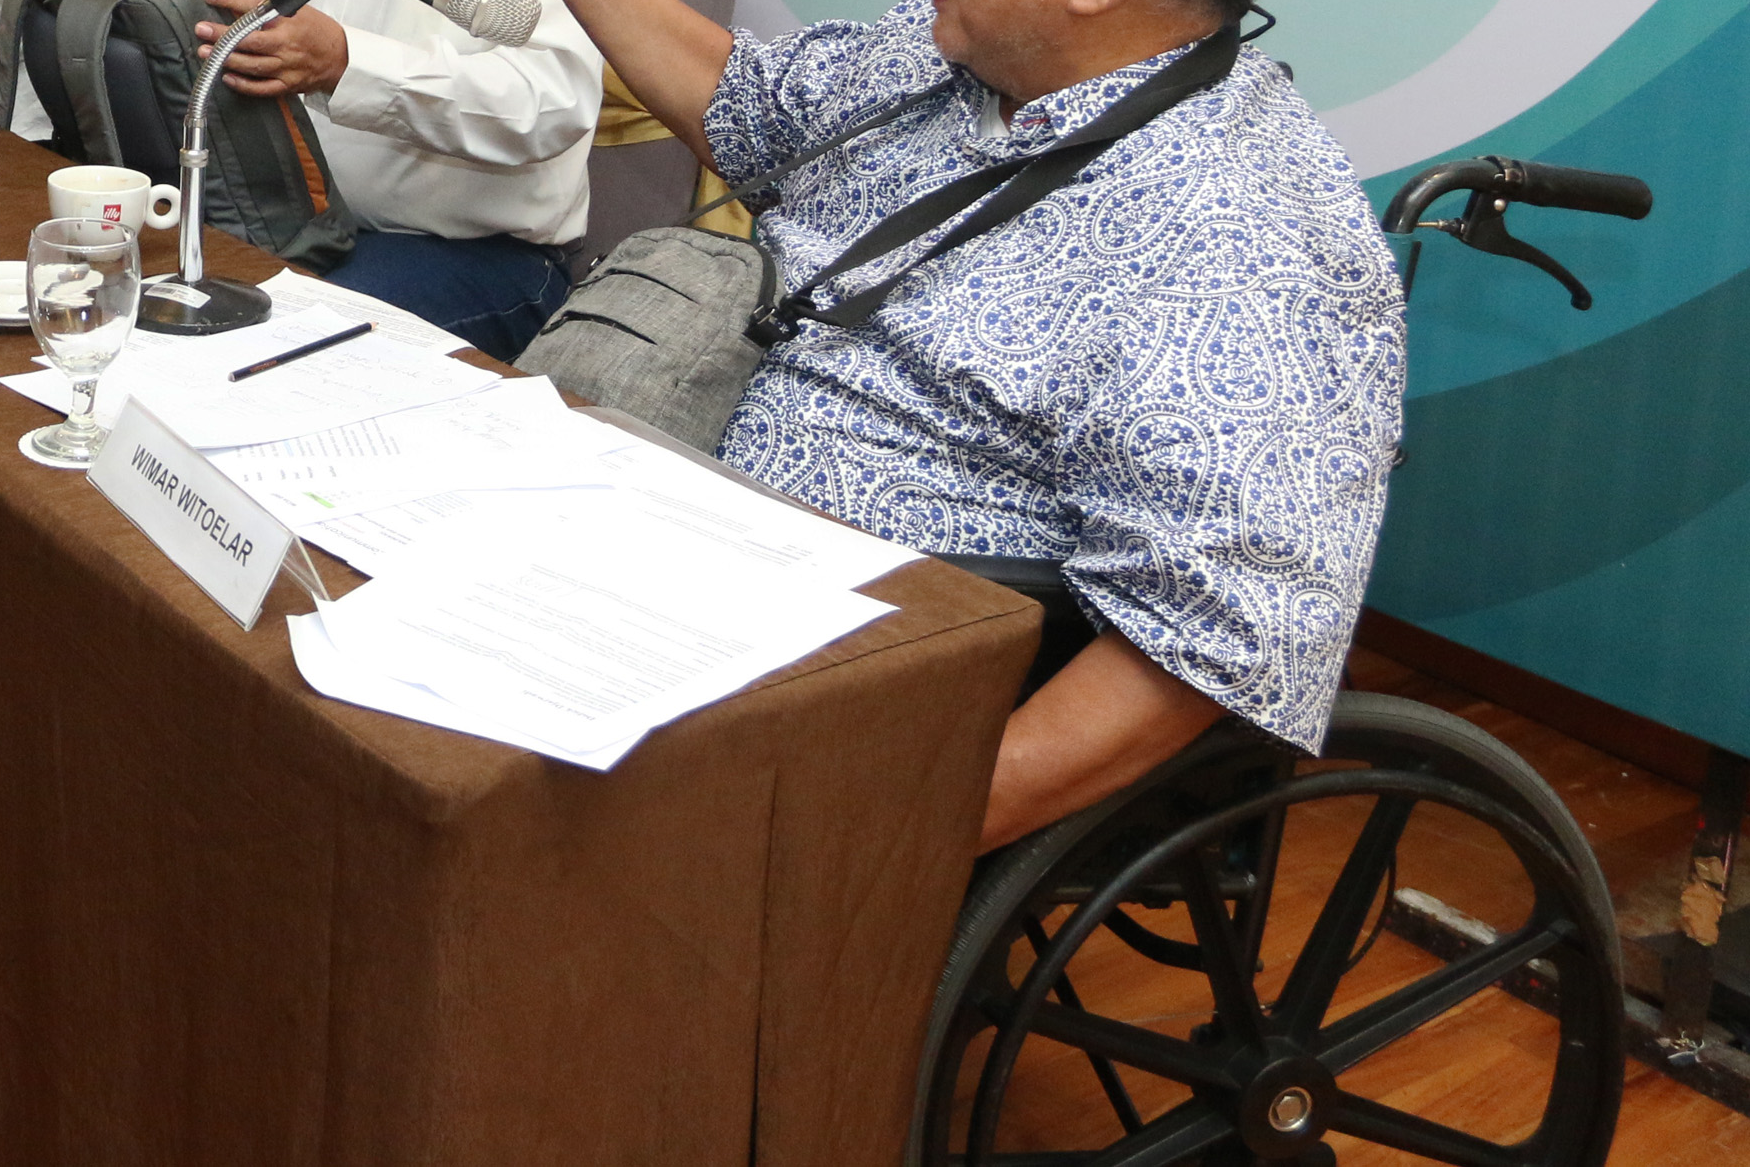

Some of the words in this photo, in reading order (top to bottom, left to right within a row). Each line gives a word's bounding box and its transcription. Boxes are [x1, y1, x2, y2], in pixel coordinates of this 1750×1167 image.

[103, 207, 121, 221] illy
[131, 443, 179, 500] WIMAR
[177, 484, 253, 567] WITOELAR
